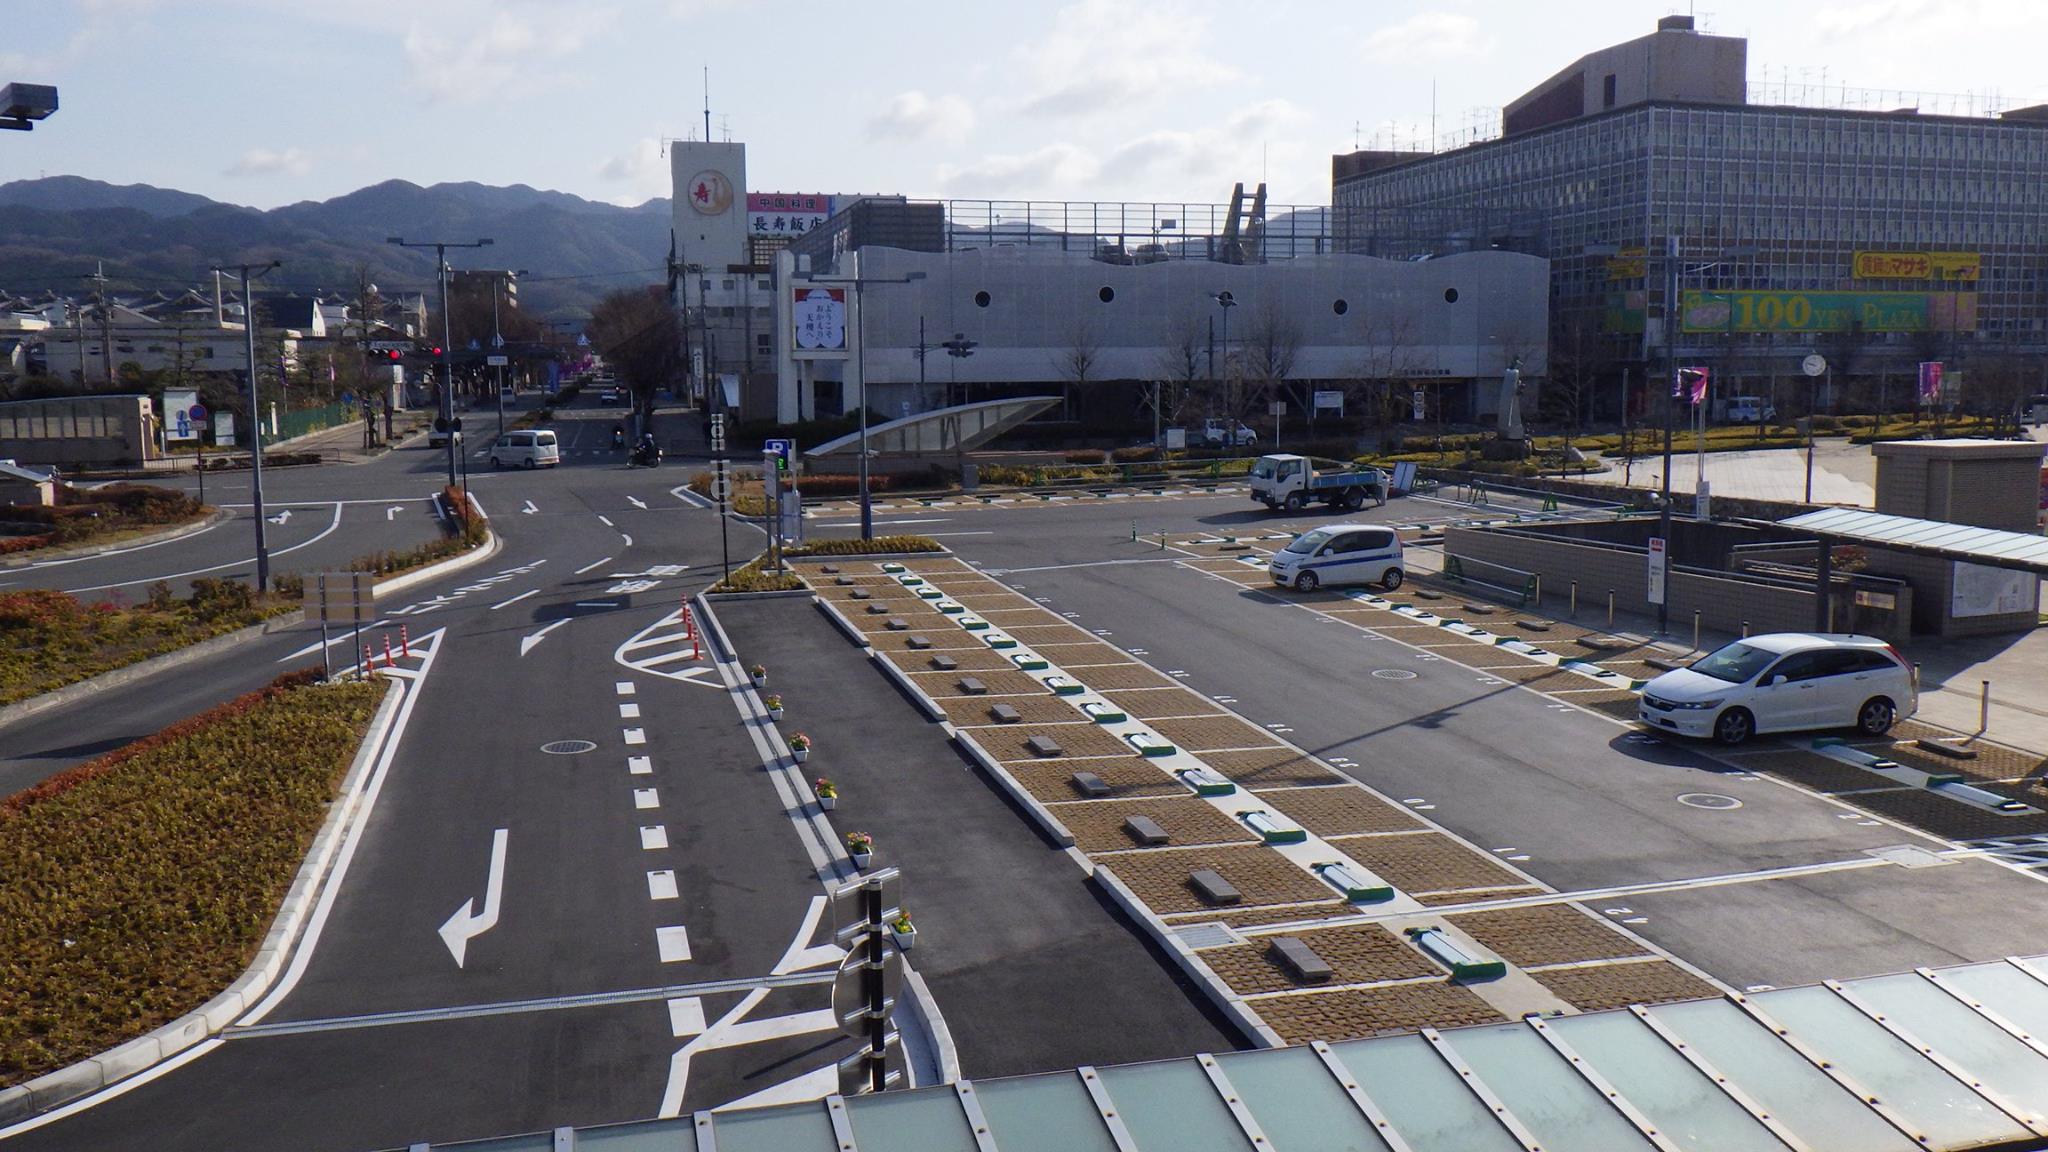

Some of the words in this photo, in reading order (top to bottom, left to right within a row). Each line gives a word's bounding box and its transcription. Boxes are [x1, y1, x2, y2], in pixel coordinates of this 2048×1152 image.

[759, 197, 816, 209] 中国料理
[753, 215, 824, 232] 長寿飯店
[1737, 295, 1811, 329] 100
